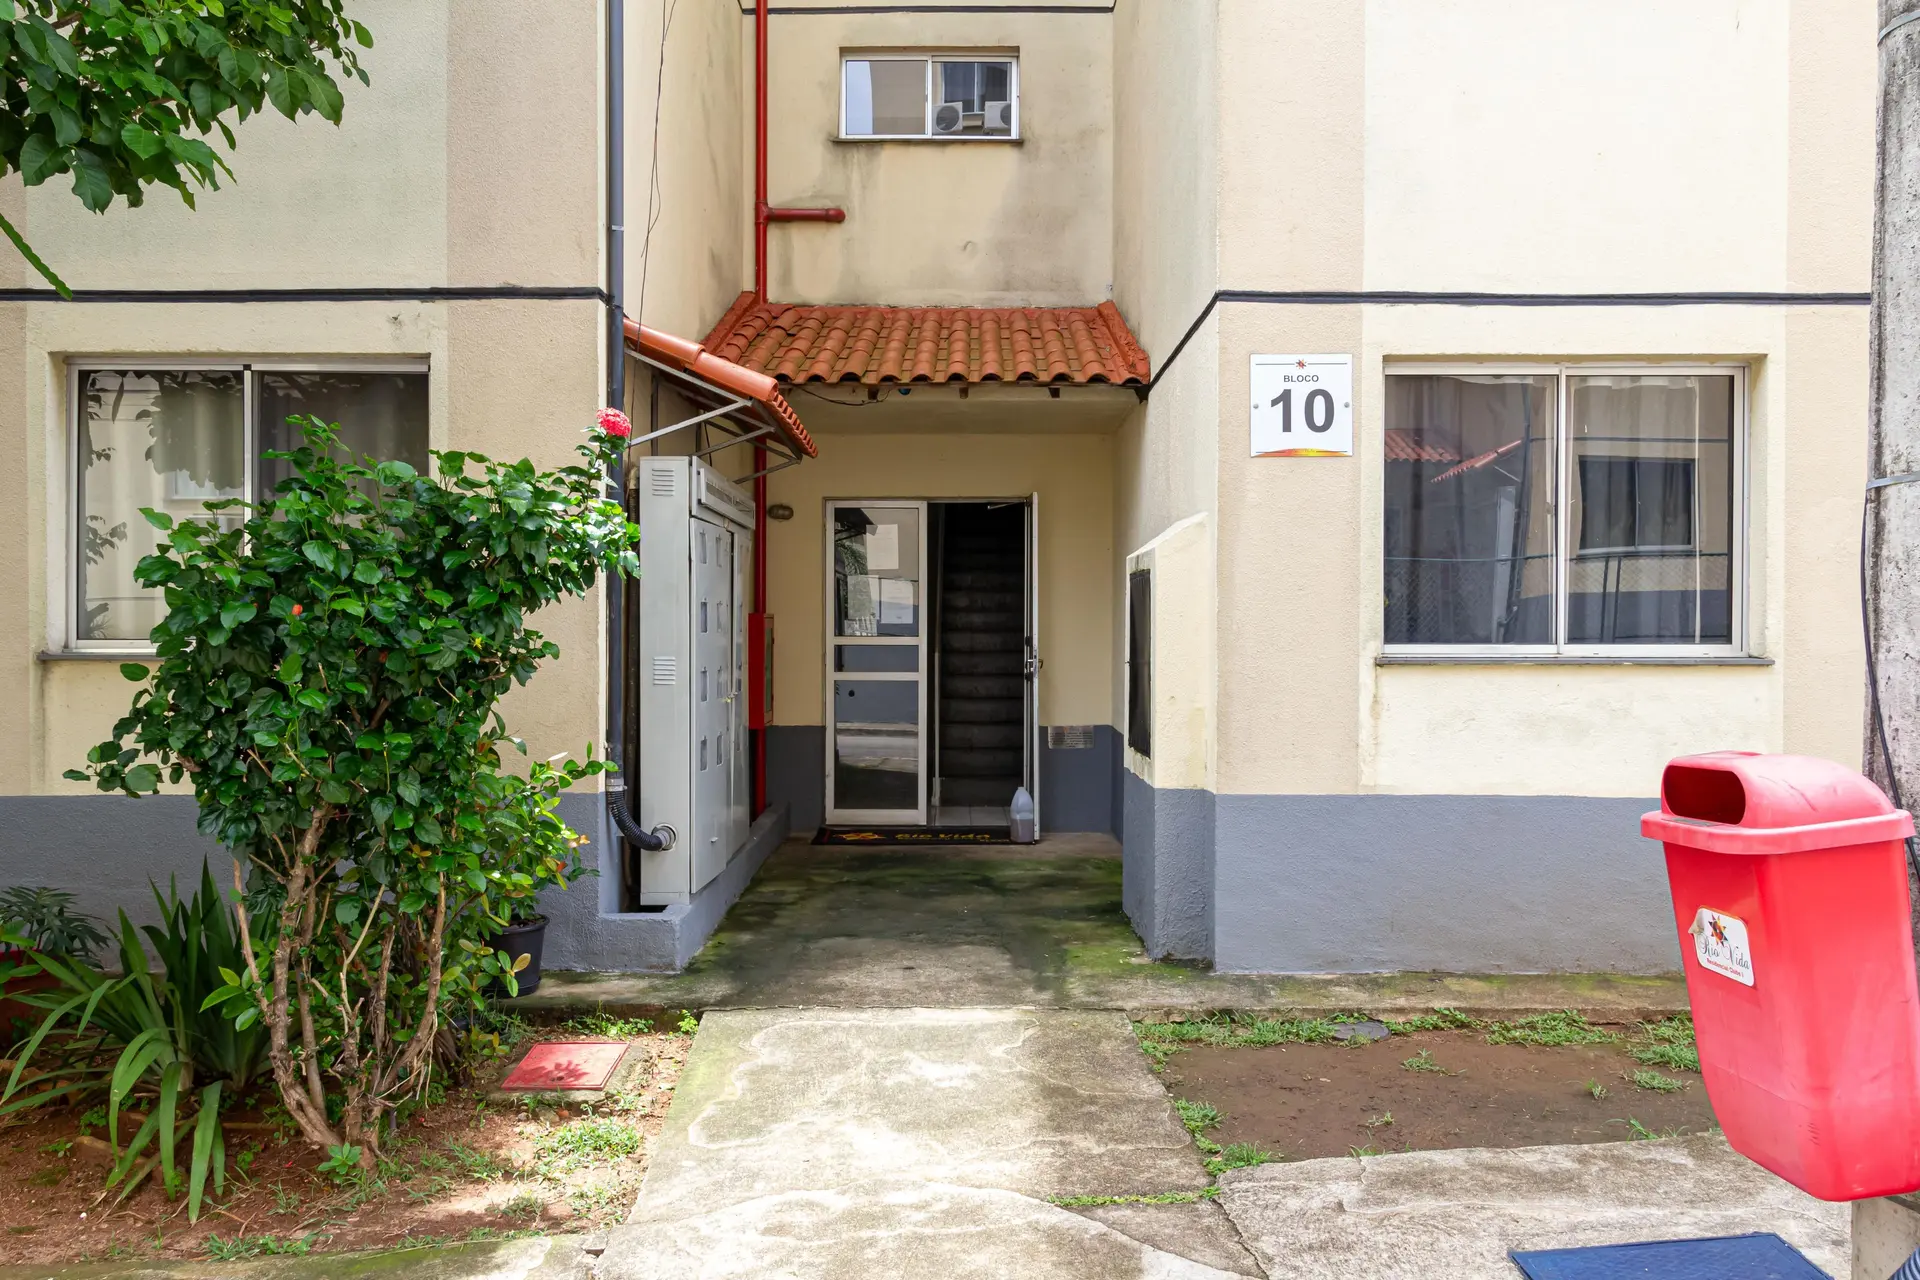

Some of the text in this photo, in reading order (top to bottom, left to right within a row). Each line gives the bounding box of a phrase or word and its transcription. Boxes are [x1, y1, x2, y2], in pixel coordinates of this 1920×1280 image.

[1270, 388, 1335, 433] 10
[1698, 933, 1749, 969] Rio Vida
